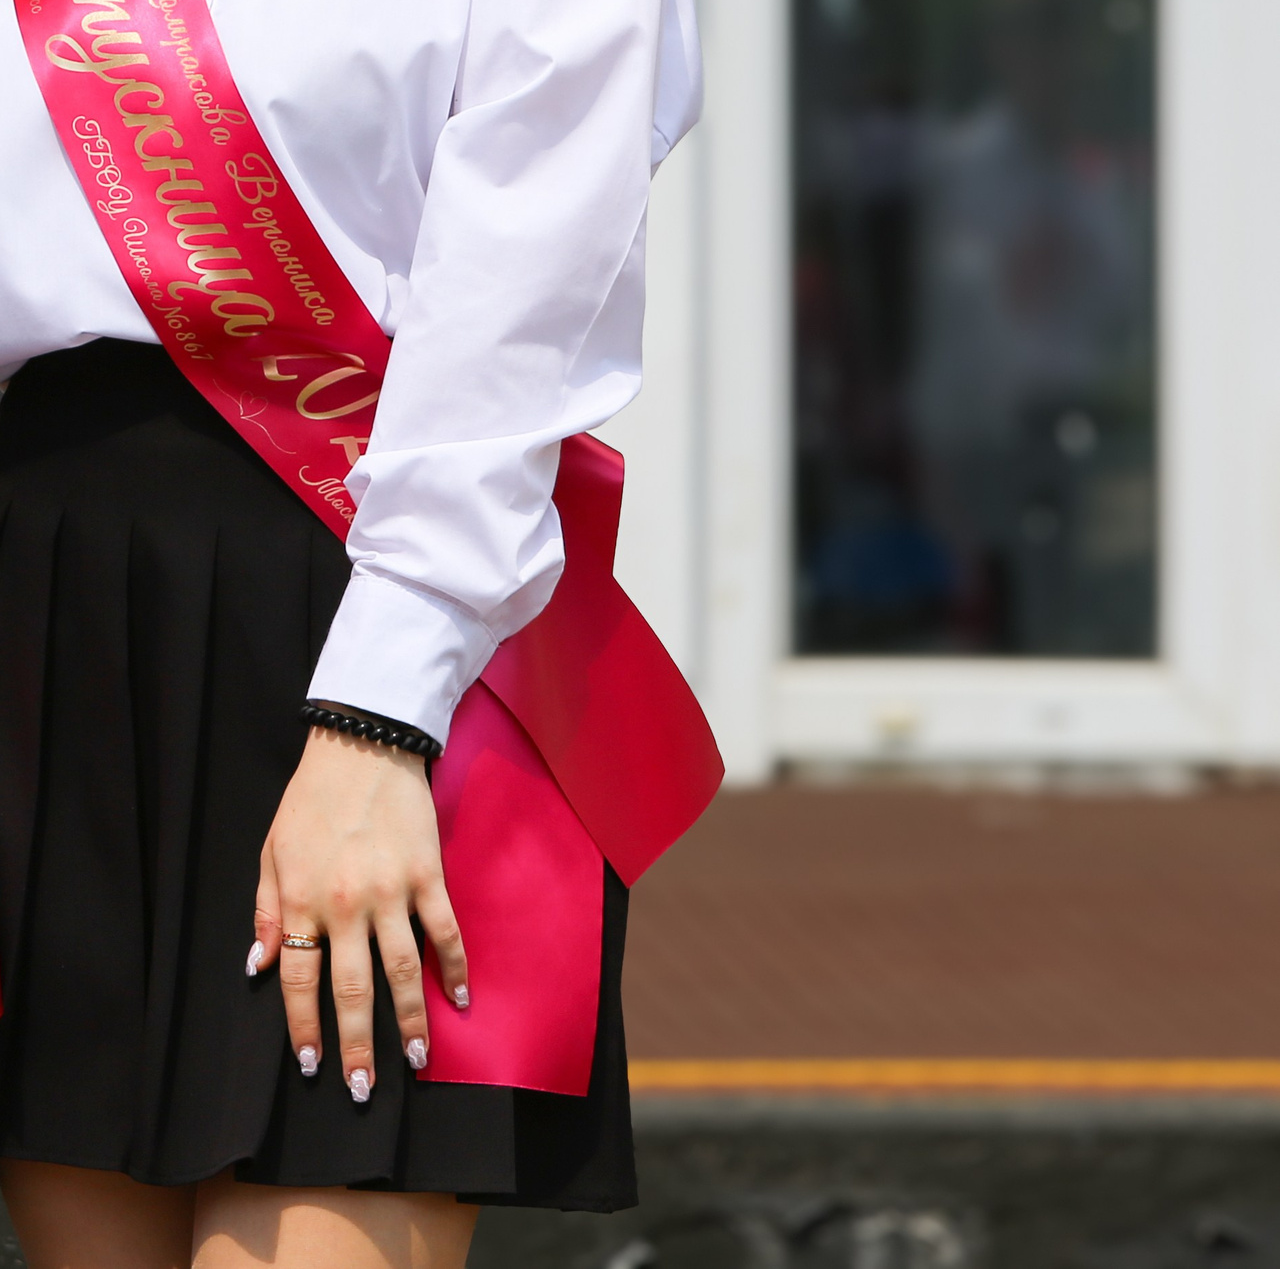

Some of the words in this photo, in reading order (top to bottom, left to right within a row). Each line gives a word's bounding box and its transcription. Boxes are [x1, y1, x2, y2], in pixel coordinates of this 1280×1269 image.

[72, 115, 134, 221] ГБОУ
[122, 217, 164, 302] Школа
[225, 151, 335, 327] Вероника
